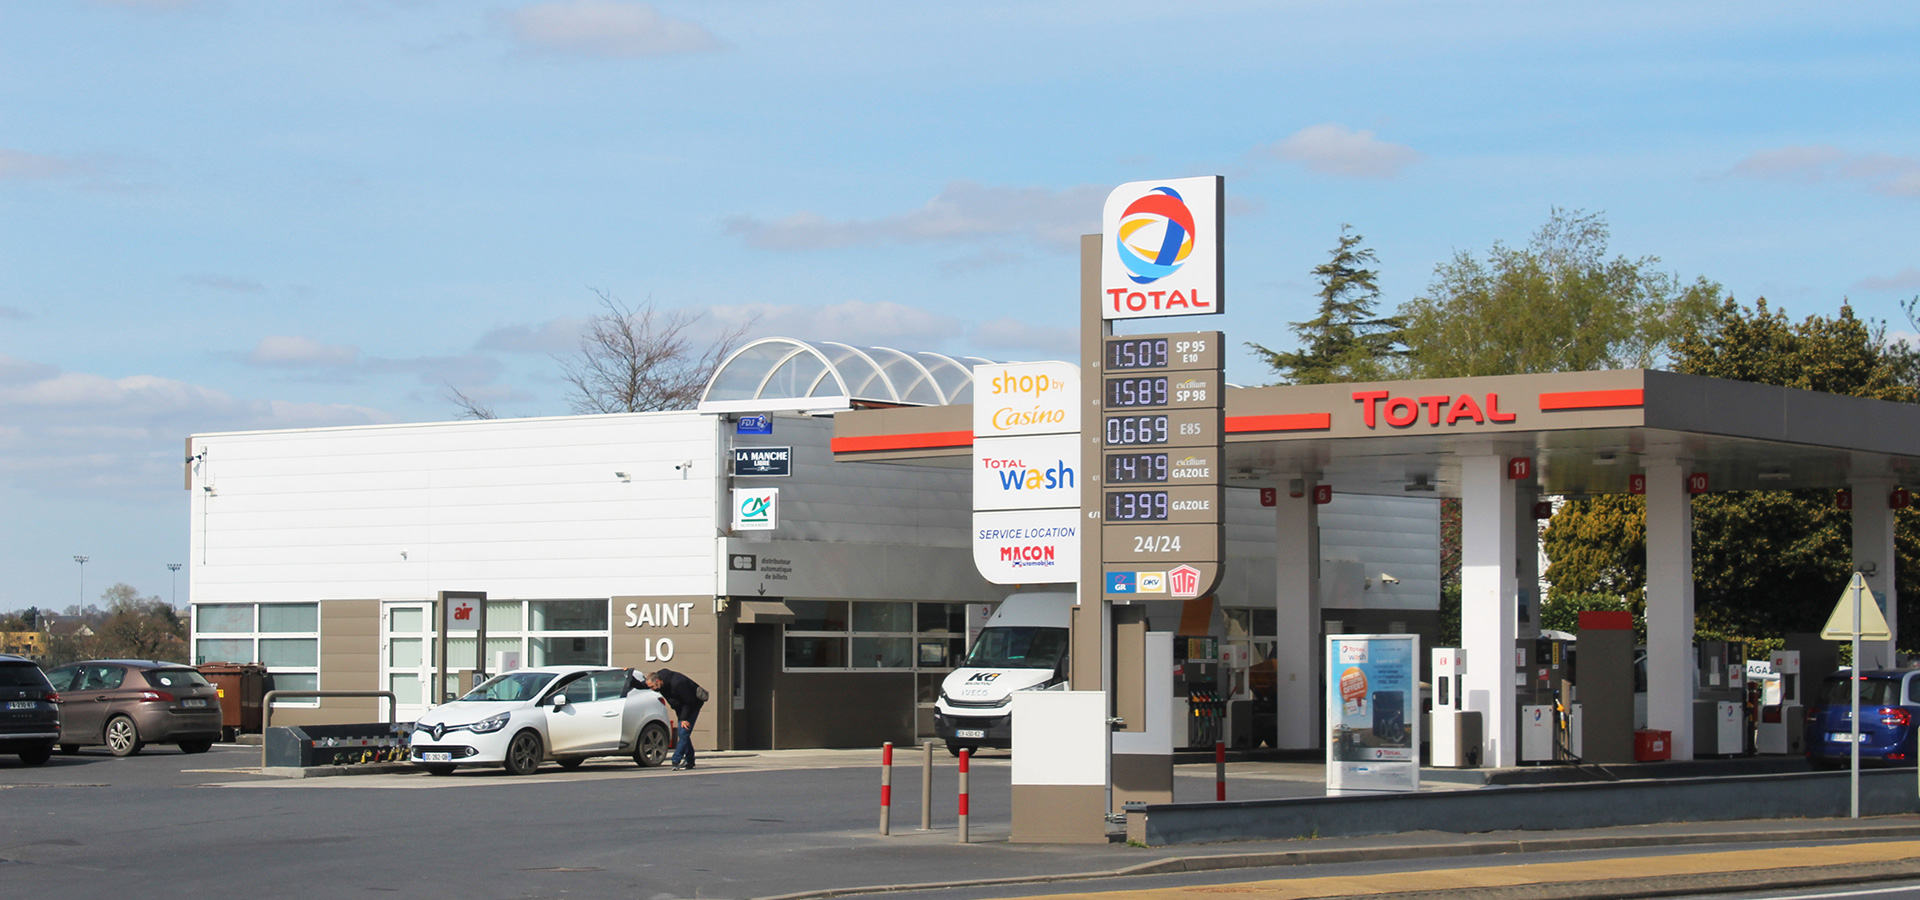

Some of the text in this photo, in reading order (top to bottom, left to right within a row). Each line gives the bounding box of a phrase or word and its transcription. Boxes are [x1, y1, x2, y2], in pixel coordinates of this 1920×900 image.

[1106, 288, 1210, 313] TOTAL
[1115, 340, 1205, 367] 1.509 SP 95
[1183, 353, 1198, 363] E10
[992, 369, 1065, 399] shop by
[1115, 379, 1206, 405] 1.589 SP 98
[992, 405, 1065, 431] Casino
[1352, 390, 1516, 429] TOTAL
[741, 419, 755, 427] FDJ
[1107, 417, 1201, 444] 0.669 E85
[737, 451, 787, 461] LA MANCHE
[982, 458, 1026, 469] TOTAL
[999, 459, 1074, 490] wash
[1115, 455, 1209, 481] 1.479 GAZOLE
[1514, 462, 1526, 474] 11
[1635, 479, 1643, 491] 9
[1691, 477, 1705, 489] 10
[1265, 491, 1271, 502] 5
[1318, 489, 1326, 500] 6
[1115, 493, 1209, 519] 1.399 GAZOLE
[979, 527, 1076, 540] SERVICE LOCATION
[1134, 535, 1181, 552] 24/24
[1000, 545, 1054, 561] MACON
[733, 556, 752, 569] CB
[1114, 583, 1127, 591] GR
[1172, 568, 1197, 593] UTA
[455, 602, 473, 620] air
[625, 602, 695, 627] SAINT
[645, 637, 675, 662] LO
[961, 689, 988, 697] IVECO
